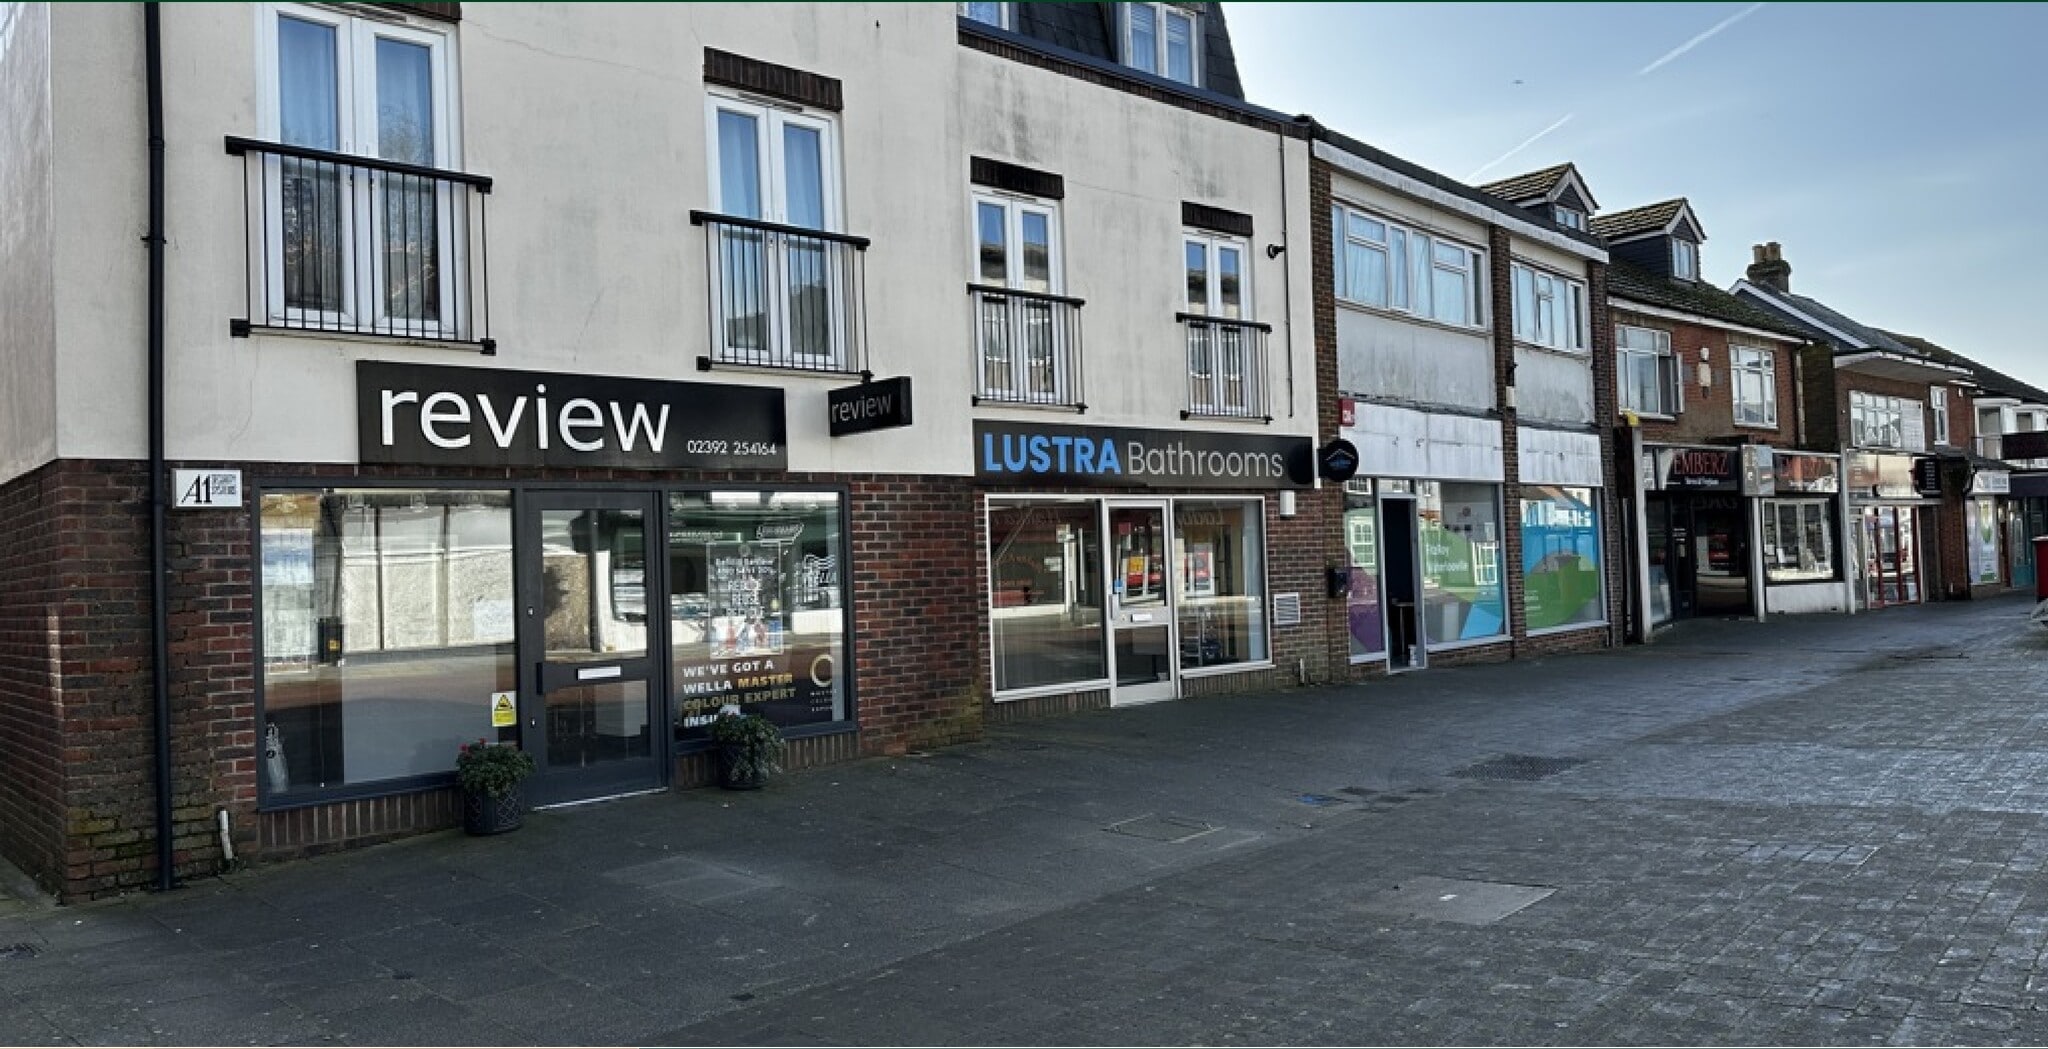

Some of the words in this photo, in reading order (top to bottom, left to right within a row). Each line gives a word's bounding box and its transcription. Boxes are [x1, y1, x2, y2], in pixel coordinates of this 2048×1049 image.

[381, 383, 671, 452] review
[832, 394, 892, 423] review
[687, 440, 727, 454] 02392
[983, 432, 1122, 475] LUSTRA
[1127, 441, 1284, 477] Bathrooms
[1673, 451, 1729, 475] EMBERZ
[181, 474, 213, 504] A1
[683, 665, 727, 677] WE'VE
[733, 660, 761, 673] GOT
[764, 659, 775, 670] A
[683, 680, 733, 694] WELLA
[737, 674, 793, 688] MASTER
[744, 689, 796, 703] EXPERT
[683, 713, 720, 728] INSI
